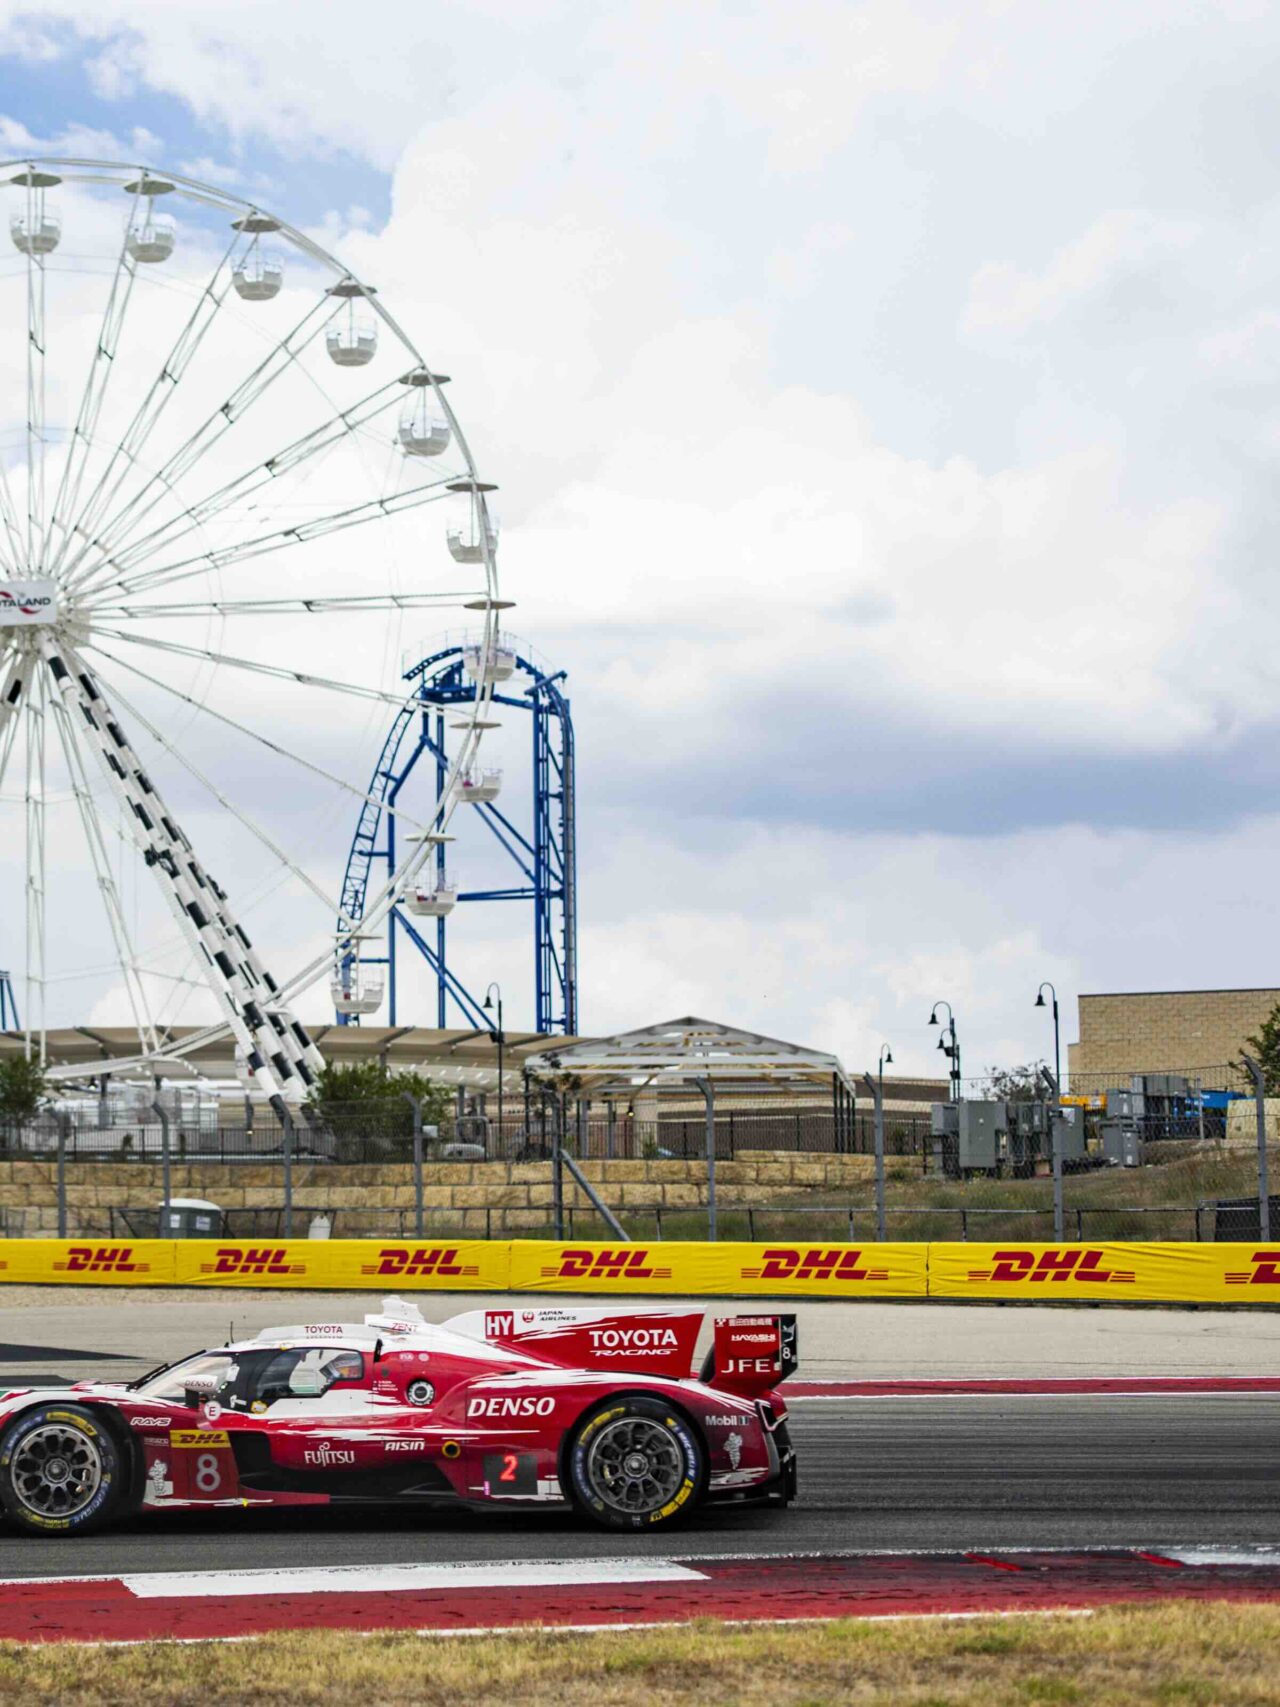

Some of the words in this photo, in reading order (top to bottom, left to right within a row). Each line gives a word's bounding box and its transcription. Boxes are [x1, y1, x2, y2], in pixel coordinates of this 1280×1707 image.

[68, 1248, 132, 1272] DHL
[216, 1249, 284, 1273] DHL
[378, 1249, 460, 1275] DHL
[560, 1250, 652, 1278] DHL
[762, 1250, 866, 1280] DHL
[992, 1251, 1111, 1282] DHL
[487, 1316, 512, 1335] HY
[589, 1329, 678, 1347] TOYOTA
[782, 1347, 791, 1359] 8
[721, 1359, 770, 1373] JFE
[208, 1407, 216, 1417] E
[467, 1397, 556, 1417] DENSO
[130, 1417, 172, 1426] RAYS
[705, 1416, 737, 1426] Mobil
[179, 1434, 225, 1444] DHL
[384, 1441, 425, 1451] AISIN
[304, 1446, 355, 1467] FUJITSU
[196, 1453, 221, 1492] 8
[499, 1455, 518, 1480] 2
